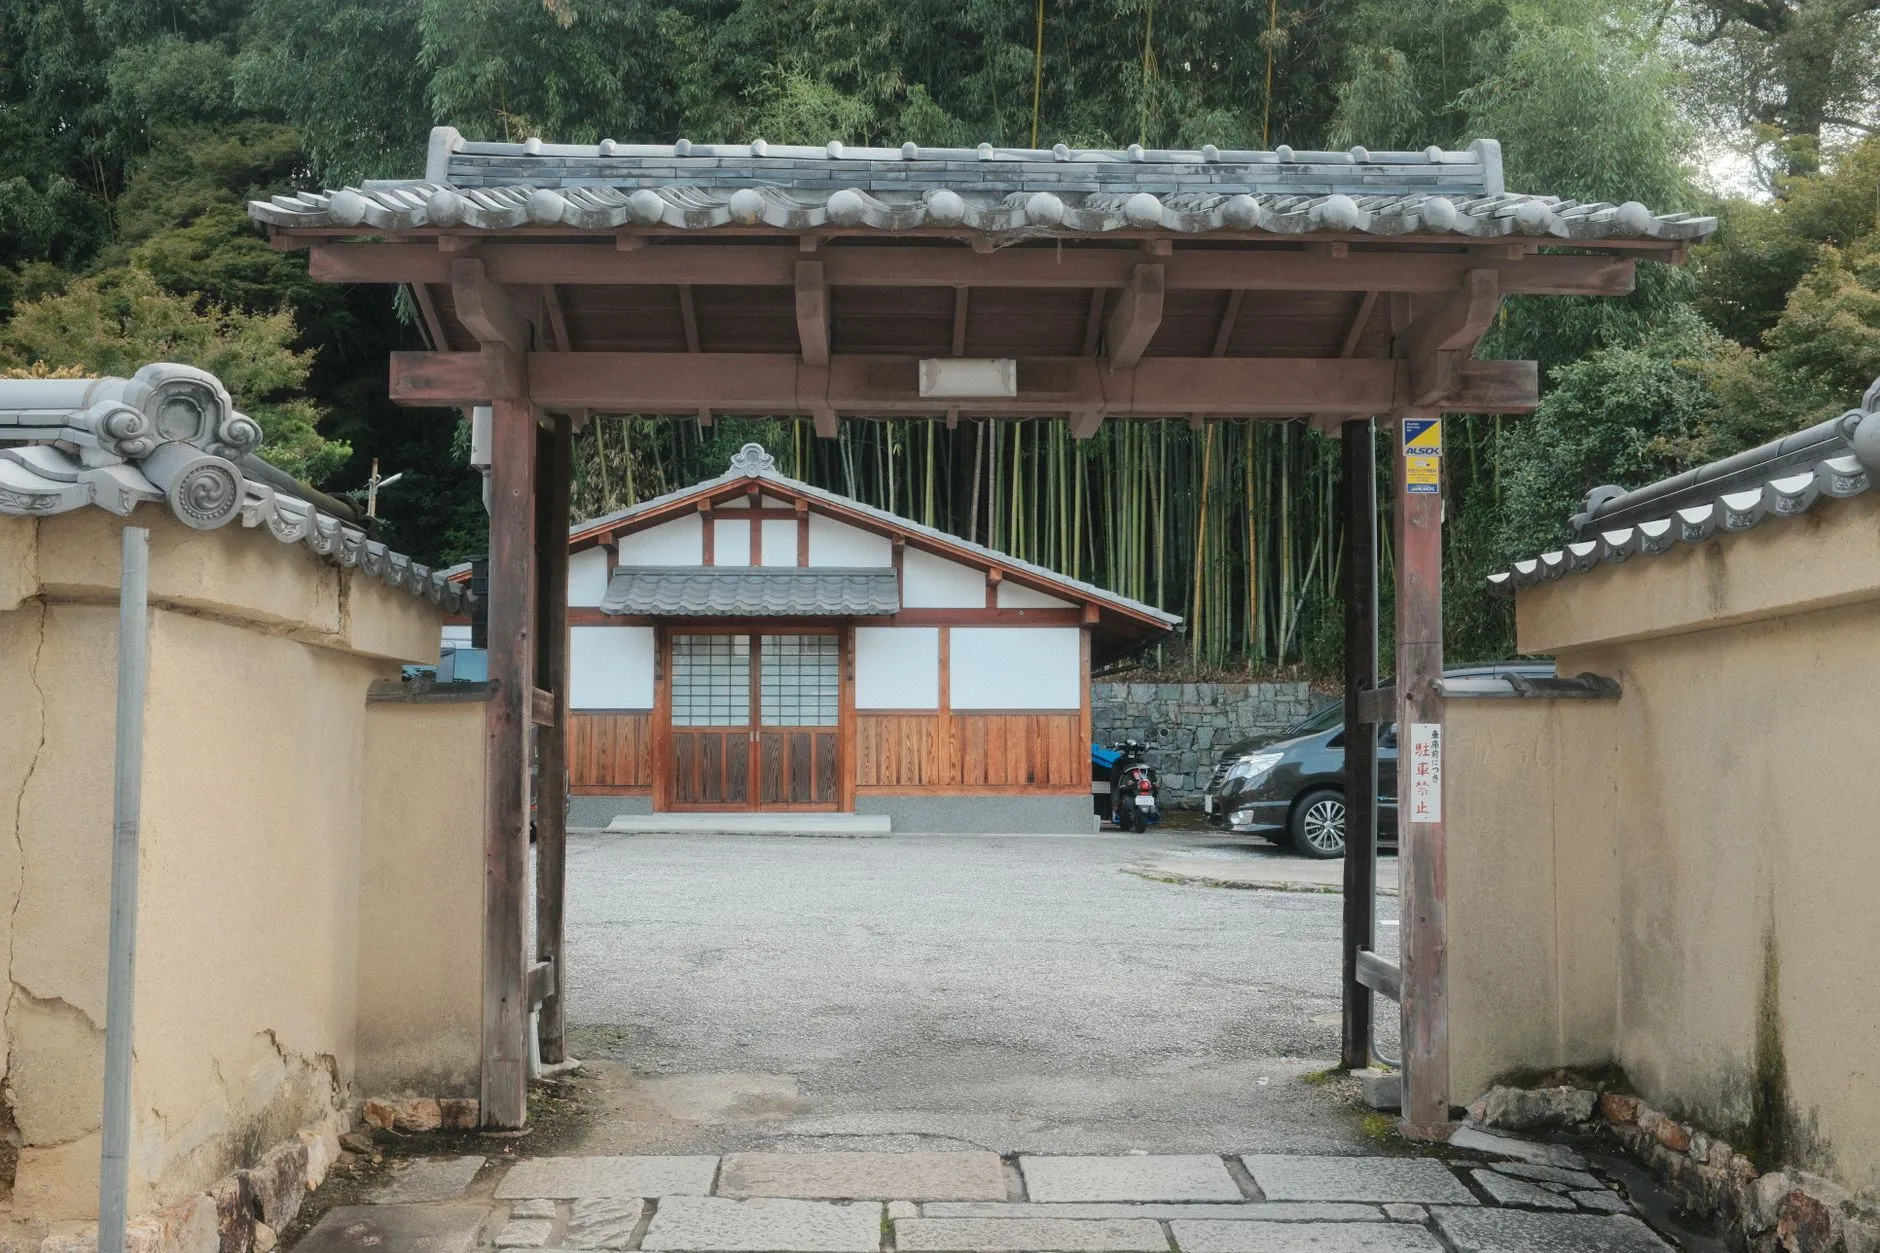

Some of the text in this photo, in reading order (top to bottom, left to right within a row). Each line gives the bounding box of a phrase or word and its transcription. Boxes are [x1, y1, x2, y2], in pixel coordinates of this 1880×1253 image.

[1406, 447, 1439, 455] ALSOK
[1415, 742, 1430, 814] 駐車禁止
